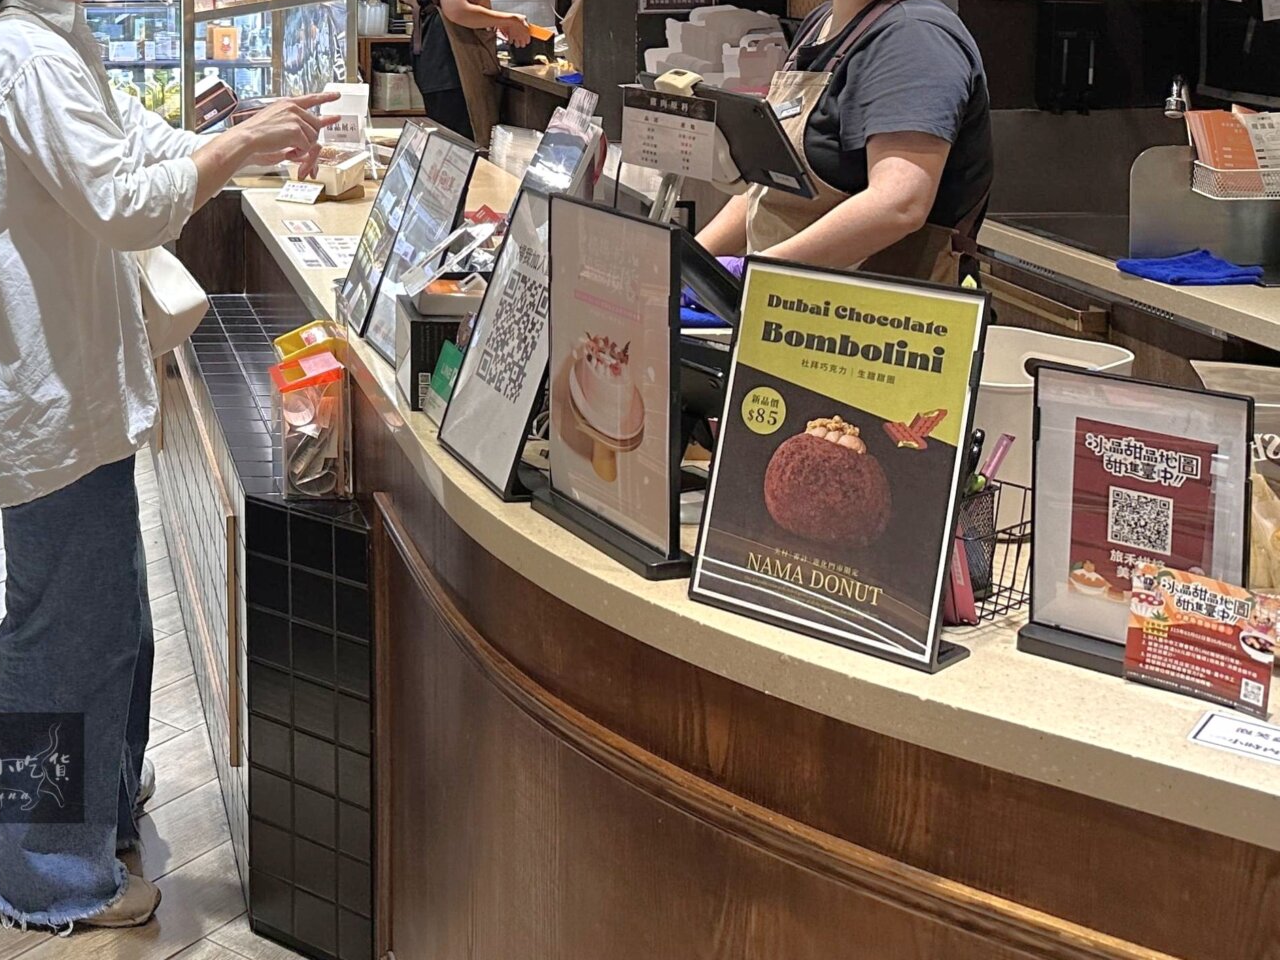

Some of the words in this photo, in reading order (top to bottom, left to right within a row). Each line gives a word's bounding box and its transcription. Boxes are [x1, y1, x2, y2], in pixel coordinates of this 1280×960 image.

[767, 293, 831, 317] Dubai
[834, 305, 948, 337] Chocolate
[761, 320, 946, 374] Bombolini
[801, 358, 848, 376] 杜拜巧克力
[747, 407, 779, 427] $85
[751, 393, 780, 409] 新品價
[1085, 433, 1201, 479] 冰品甜品地圖
[747, 552, 804, 585] NAMA
[809, 569, 884, 607] DONUT
[1161, 579, 1252, 619] 冰品甜品地圖
